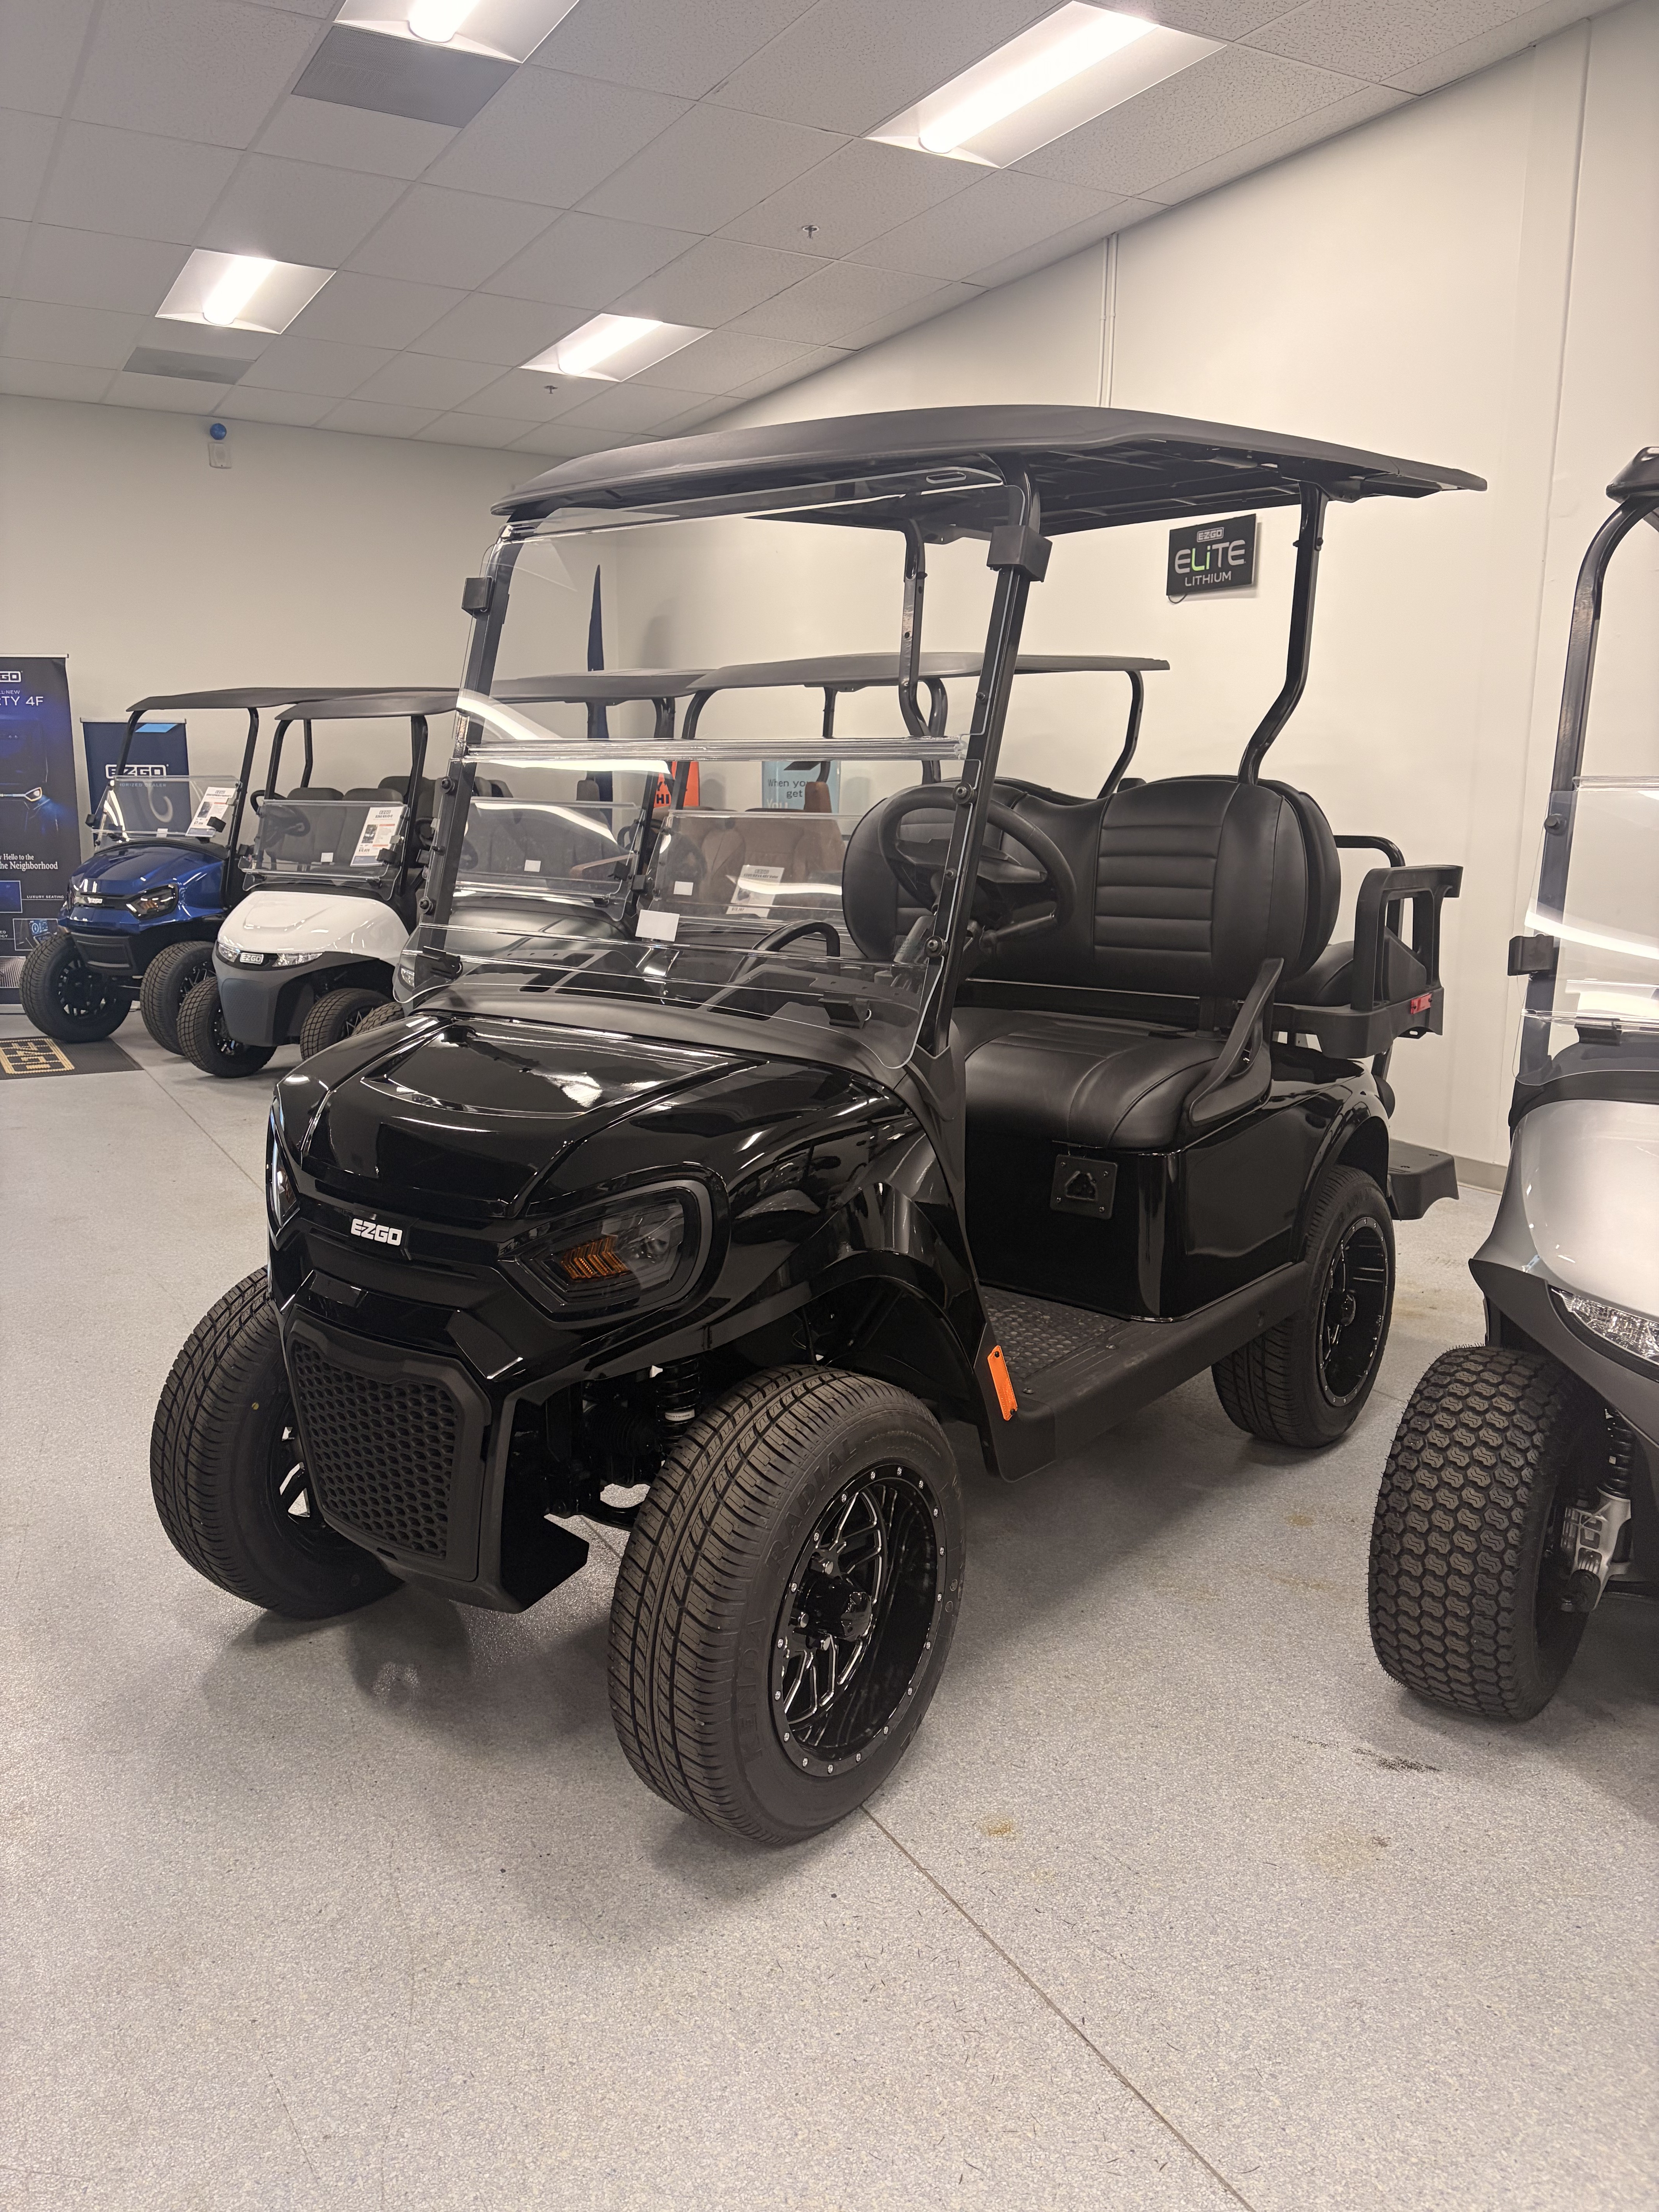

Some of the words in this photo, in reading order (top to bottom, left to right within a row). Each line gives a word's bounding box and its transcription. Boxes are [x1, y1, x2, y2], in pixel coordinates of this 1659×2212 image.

[1198, 529, 1223, 541] EZGO
[1185, 571, 1231, 586] LITHIUM
[0, 696, 20, 706] TY
[26, 696, 43, 706] 4F
[787, 790, 803, 799] get
[10, 861, 58, 871] Neighborhood
[350, 1218, 403, 1246] EZGO
[764, 1437, 857, 1575] RADIAL
